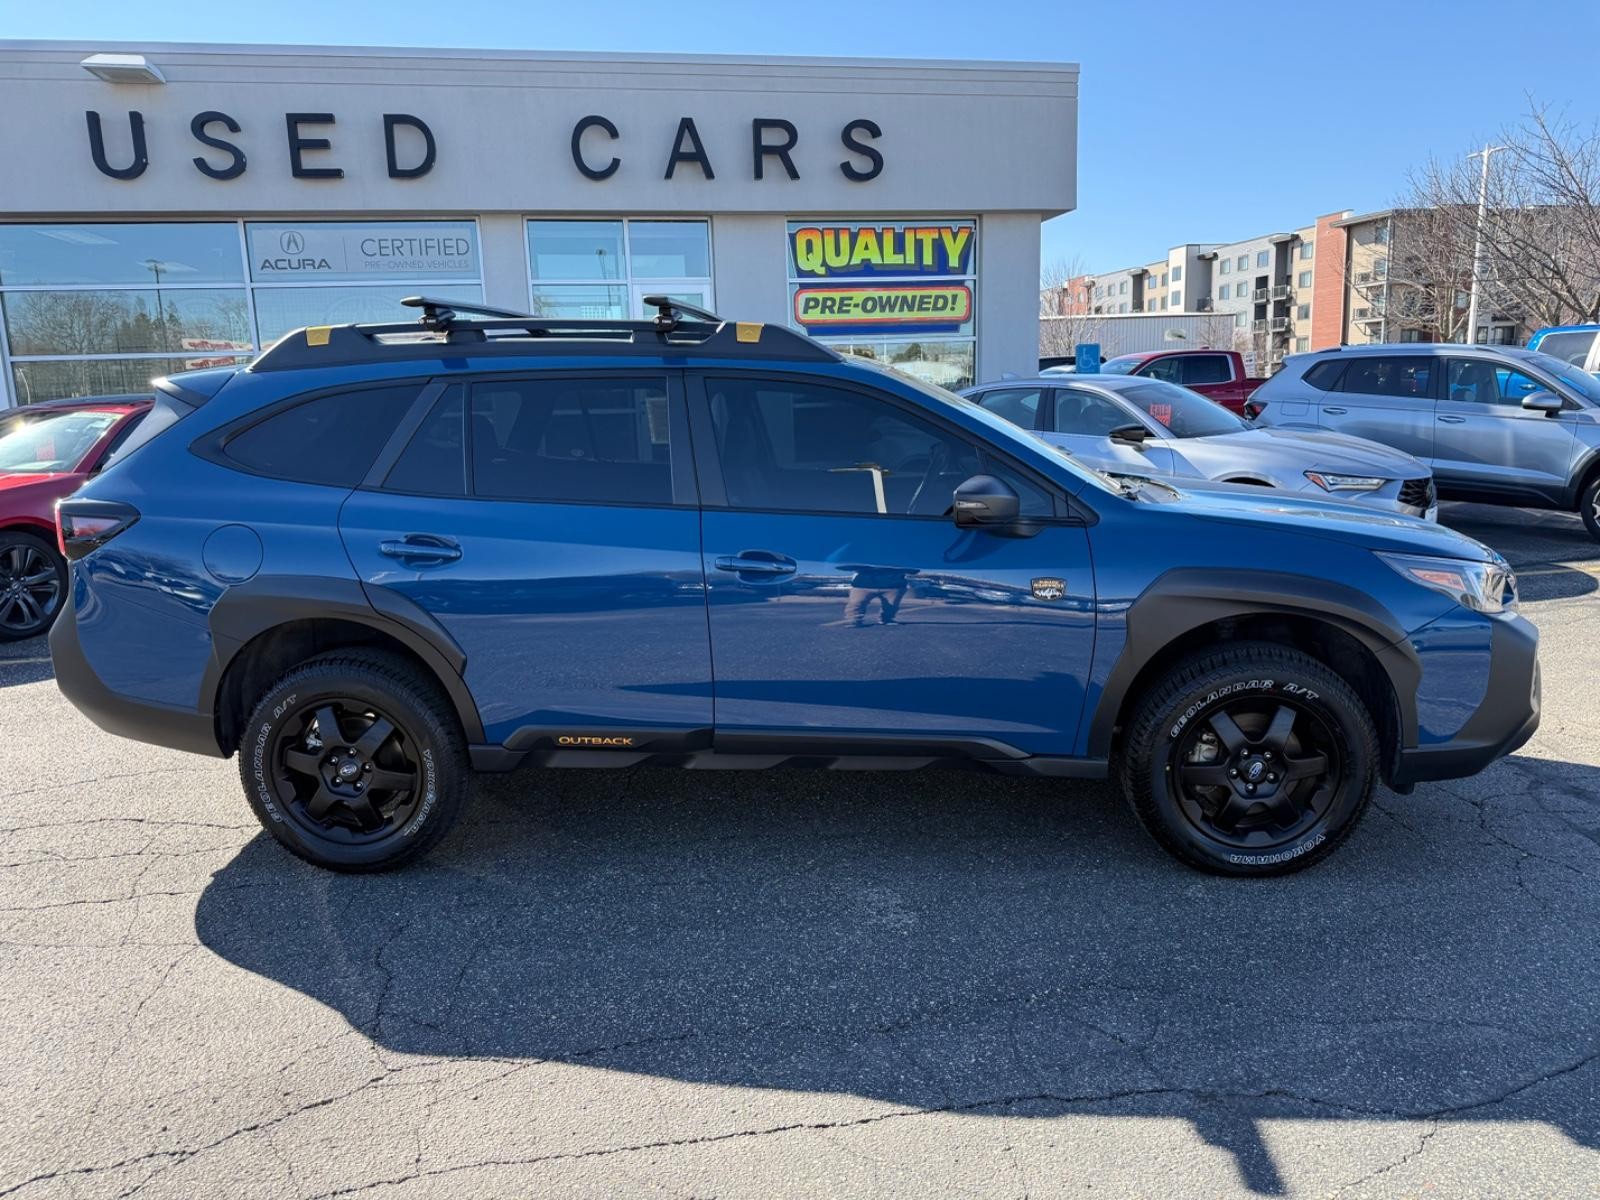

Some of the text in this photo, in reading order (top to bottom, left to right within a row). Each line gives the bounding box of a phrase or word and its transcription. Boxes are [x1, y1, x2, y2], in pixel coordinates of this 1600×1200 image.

[86, 110, 884, 182] USED CARS
[361, 238, 470, 257] CERTIFIED
[795, 227, 972, 275] QUALITY
[260, 258, 332, 271] ACURA
[364, 259, 469, 270] PRE-OWNED VEHICLES
[802, 293, 959, 315] PRE-OWNED!
[1170, 680, 1320, 738] GEOLANDAR A/T
[558, 736, 633, 745] OUTBACK
[253, 694, 297, 823] GEOLANDAR A/T
[1229, 833, 1326, 865] YOKOHAMA
